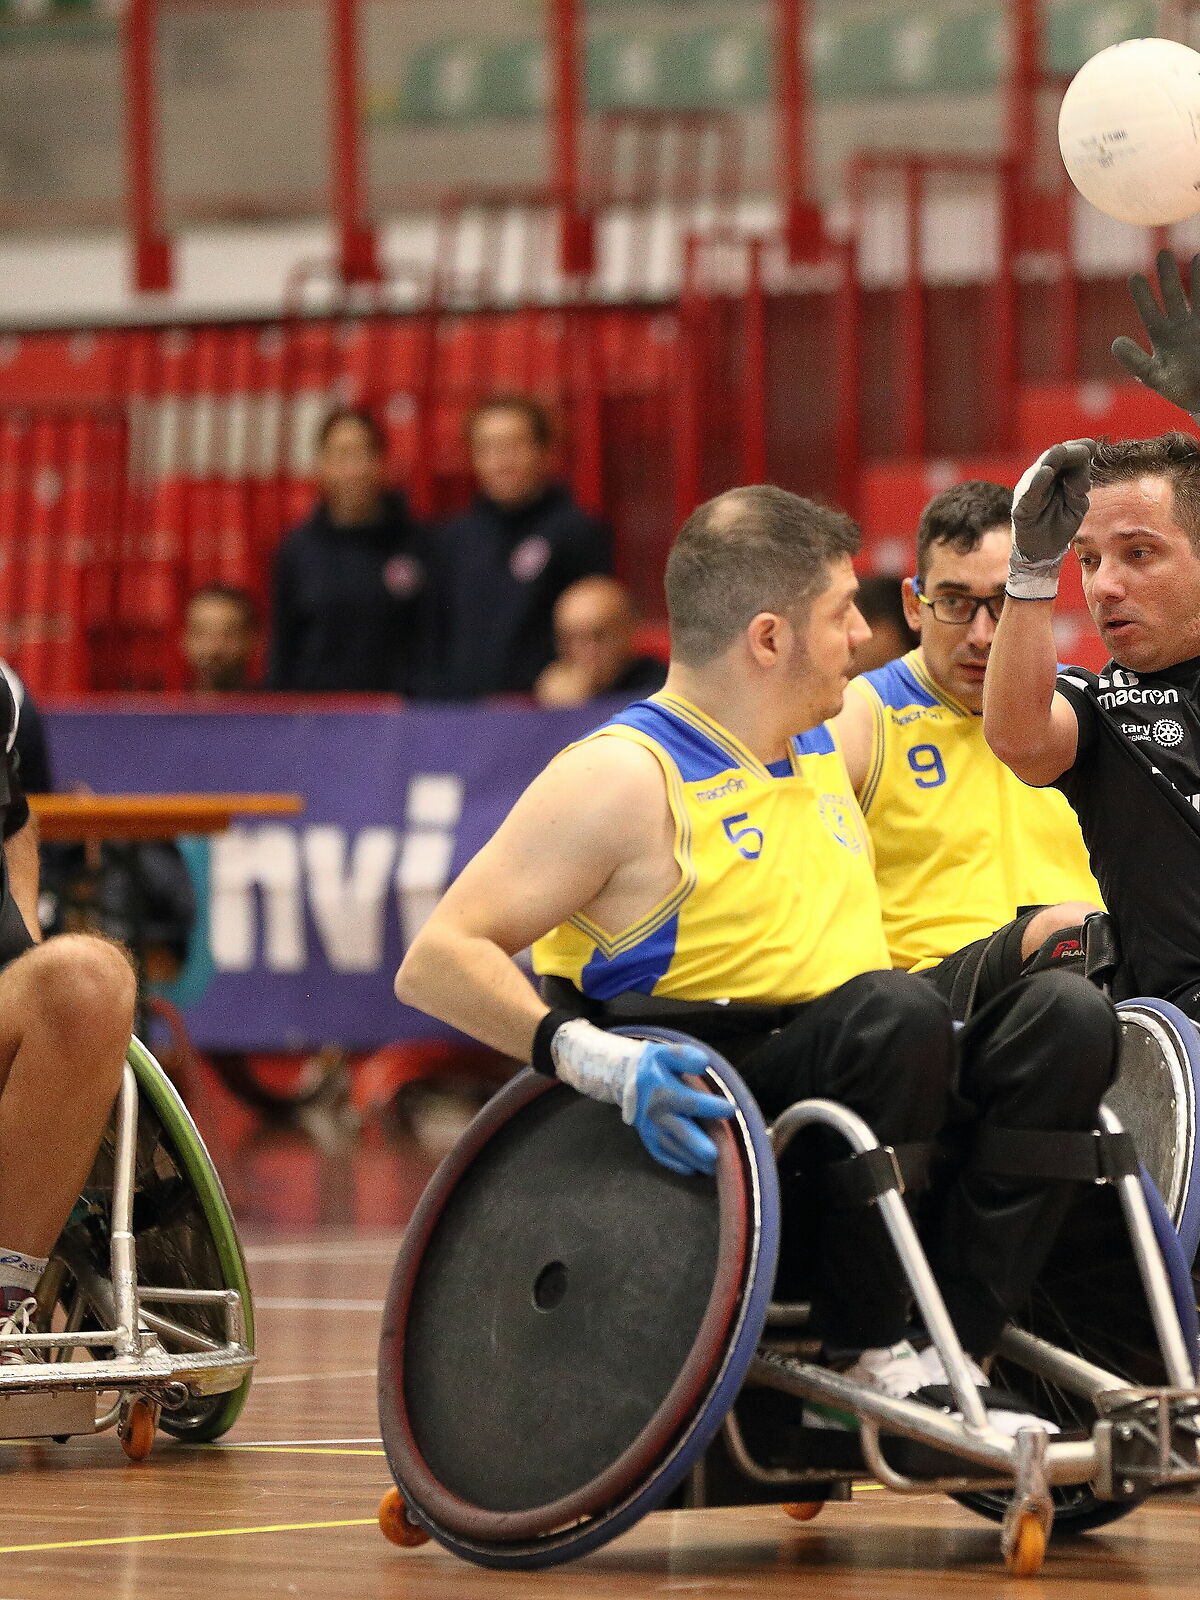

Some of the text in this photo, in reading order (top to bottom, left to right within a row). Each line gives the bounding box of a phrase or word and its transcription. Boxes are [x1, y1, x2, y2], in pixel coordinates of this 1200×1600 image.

[1096, 688, 1179, 710] macron
[1118, 722, 1151, 736] tary
[907, 744, 947, 789] 9
[722, 812, 764, 860] 5
